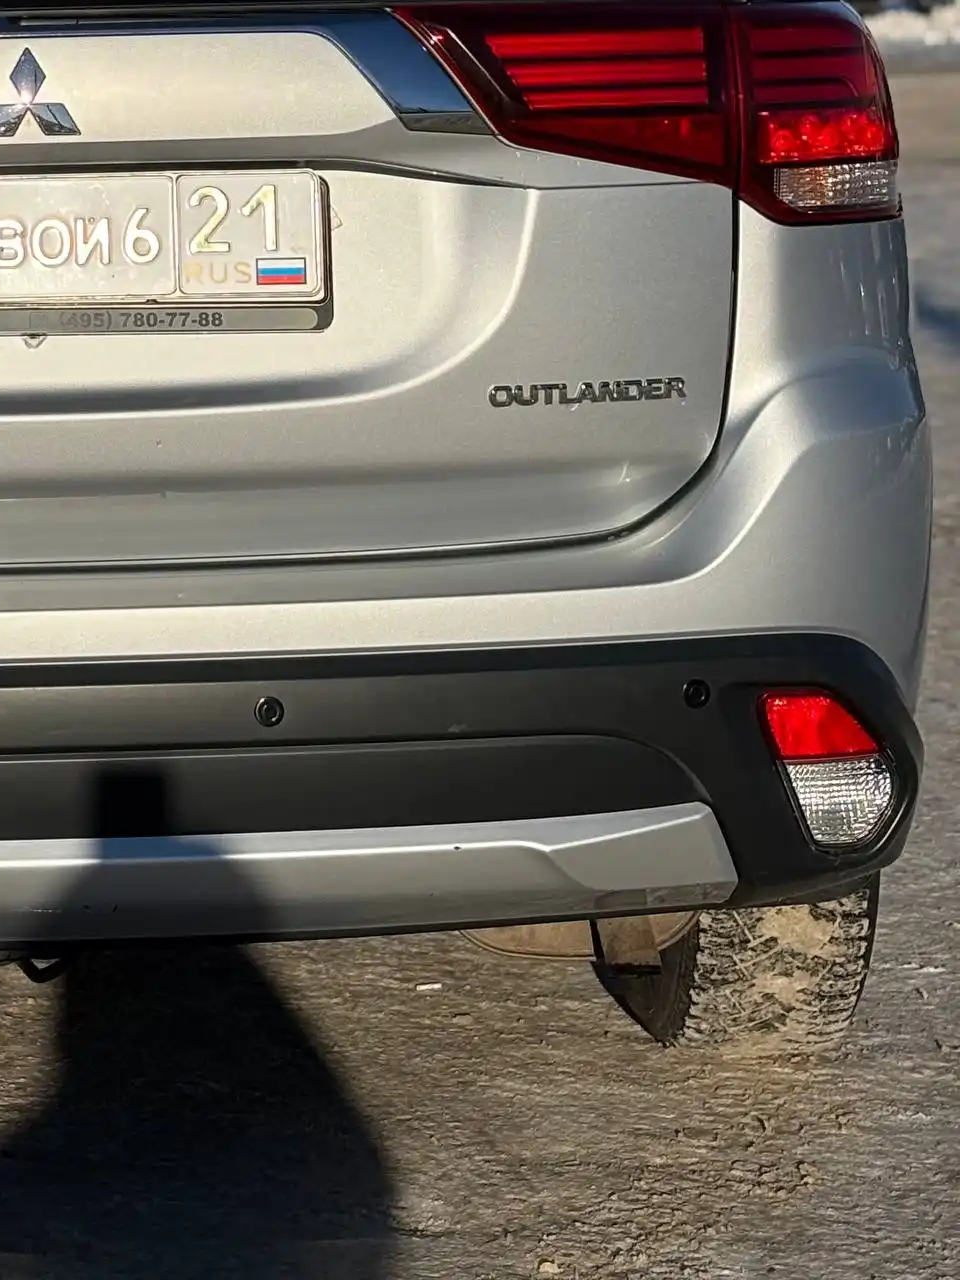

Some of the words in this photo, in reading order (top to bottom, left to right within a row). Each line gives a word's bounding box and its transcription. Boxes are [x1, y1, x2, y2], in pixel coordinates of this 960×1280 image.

[188, 183, 279, 255] 21
[122, 206, 161, 266] 6
[184, 260, 253, 286] RUS
[58, 310, 113, 331] (495)
[119, 311, 225, 329] 780-77-88
[488, 376, 688, 408] OUTLANDER
